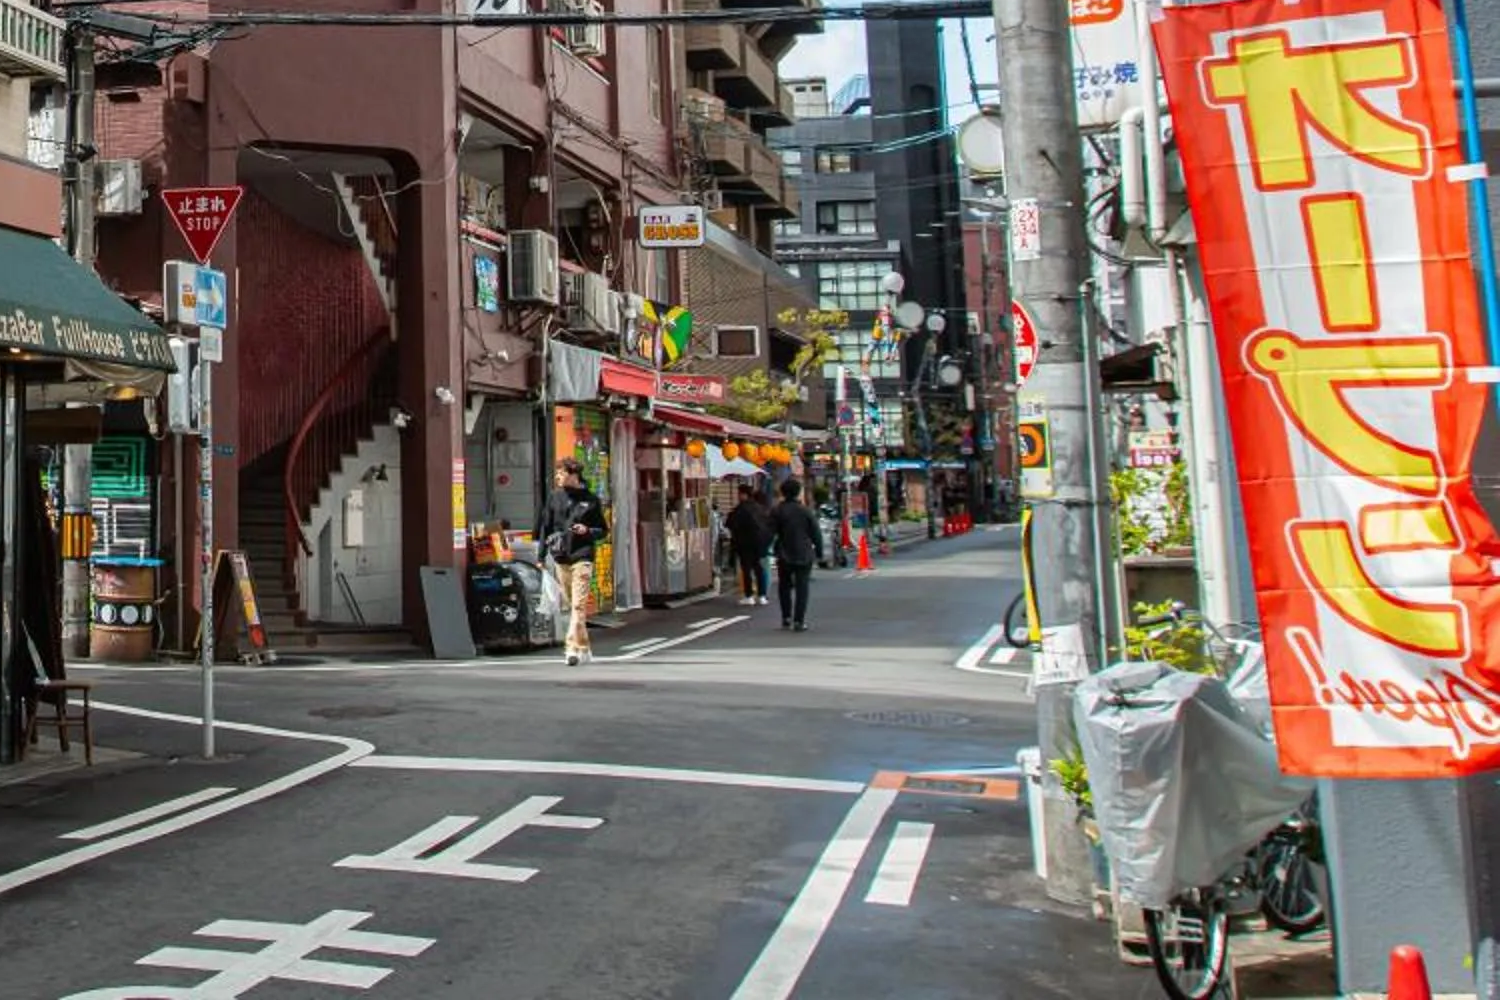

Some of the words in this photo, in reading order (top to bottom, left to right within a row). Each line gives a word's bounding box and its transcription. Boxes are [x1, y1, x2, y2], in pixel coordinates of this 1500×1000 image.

[178, 195, 227, 214] 止まれ
[187, 216, 220, 232] STOP
[52, 315, 125, 358] FullHouse
